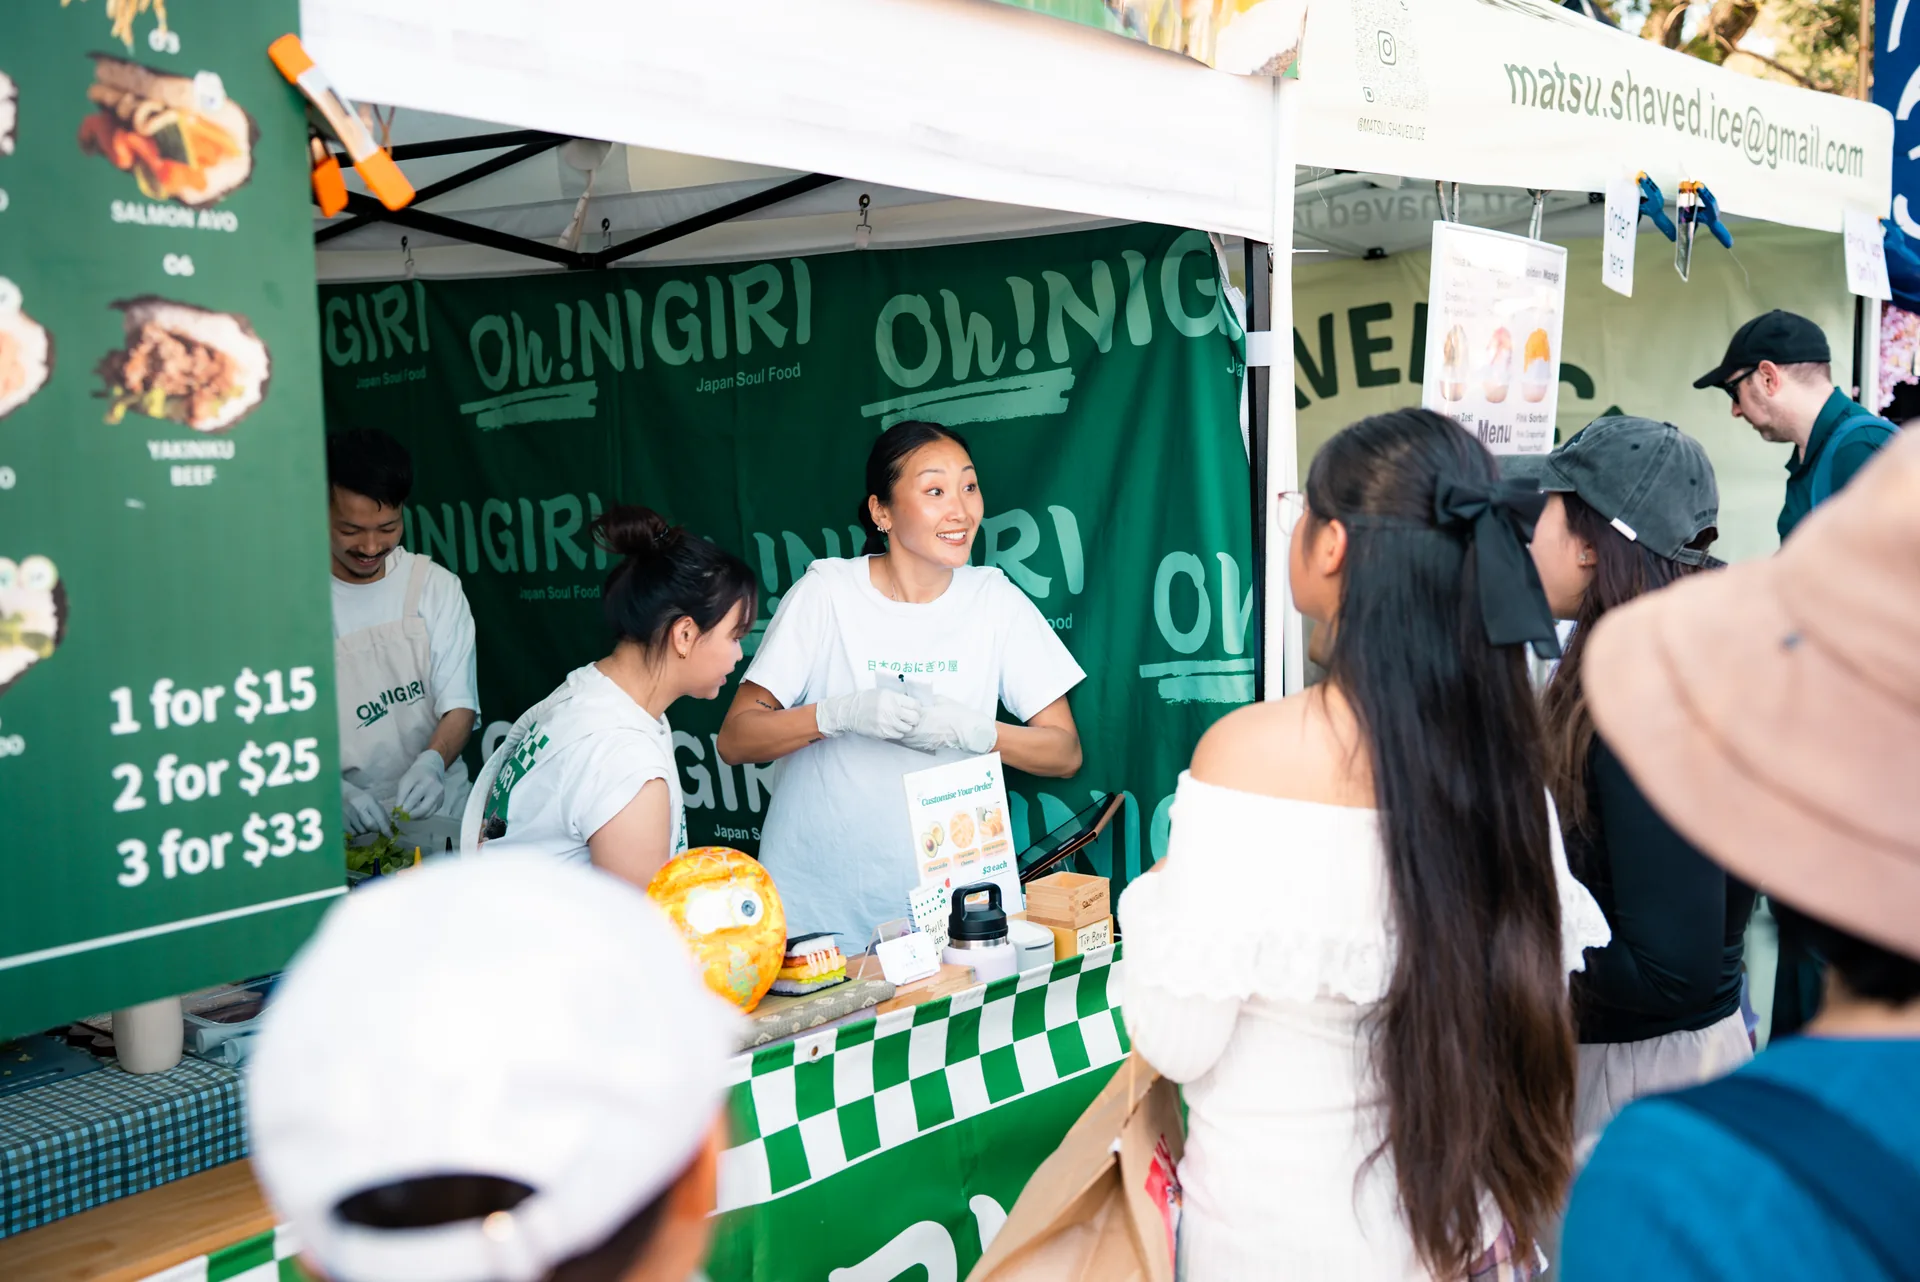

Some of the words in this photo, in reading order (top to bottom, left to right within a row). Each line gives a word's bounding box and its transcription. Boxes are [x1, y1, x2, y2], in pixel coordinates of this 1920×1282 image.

[1503, 61, 1865, 179] matsu.shaved.ice@gmail.com
[111, 200, 194, 229] SALMON
[198, 206, 238, 232] AVO
[163, 253, 195, 277] 06
[469, 258, 813, 392] Oh!NIGIRI
[696, 377, 734, 394] Japan
[736, 368, 765, 386] Soul
[768, 361, 801, 380] Food
[1477, 420, 1512, 443] Menu
[147, 440, 235, 460] YAKINIKU
[170, 465, 216, 487] BEEF
[547, 585, 571, 599] Soul
[573, 584, 600, 598] Food
[110, 686, 142, 736] 1
[150, 677, 226, 730] for
[234, 665, 318, 724] $15
[112, 763, 146, 813] 2
[154, 753, 229, 805] for
[239, 736, 320, 797] $25
[921, 791, 957, 807] Customise
[957, 784, 975, 799] Your
[974, 780, 993, 793] Order
[117, 838, 149, 887] 3
[159, 827, 233, 879] for
[242, 807, 324, 869] $33
[714, 824, 749, 841] Japan
